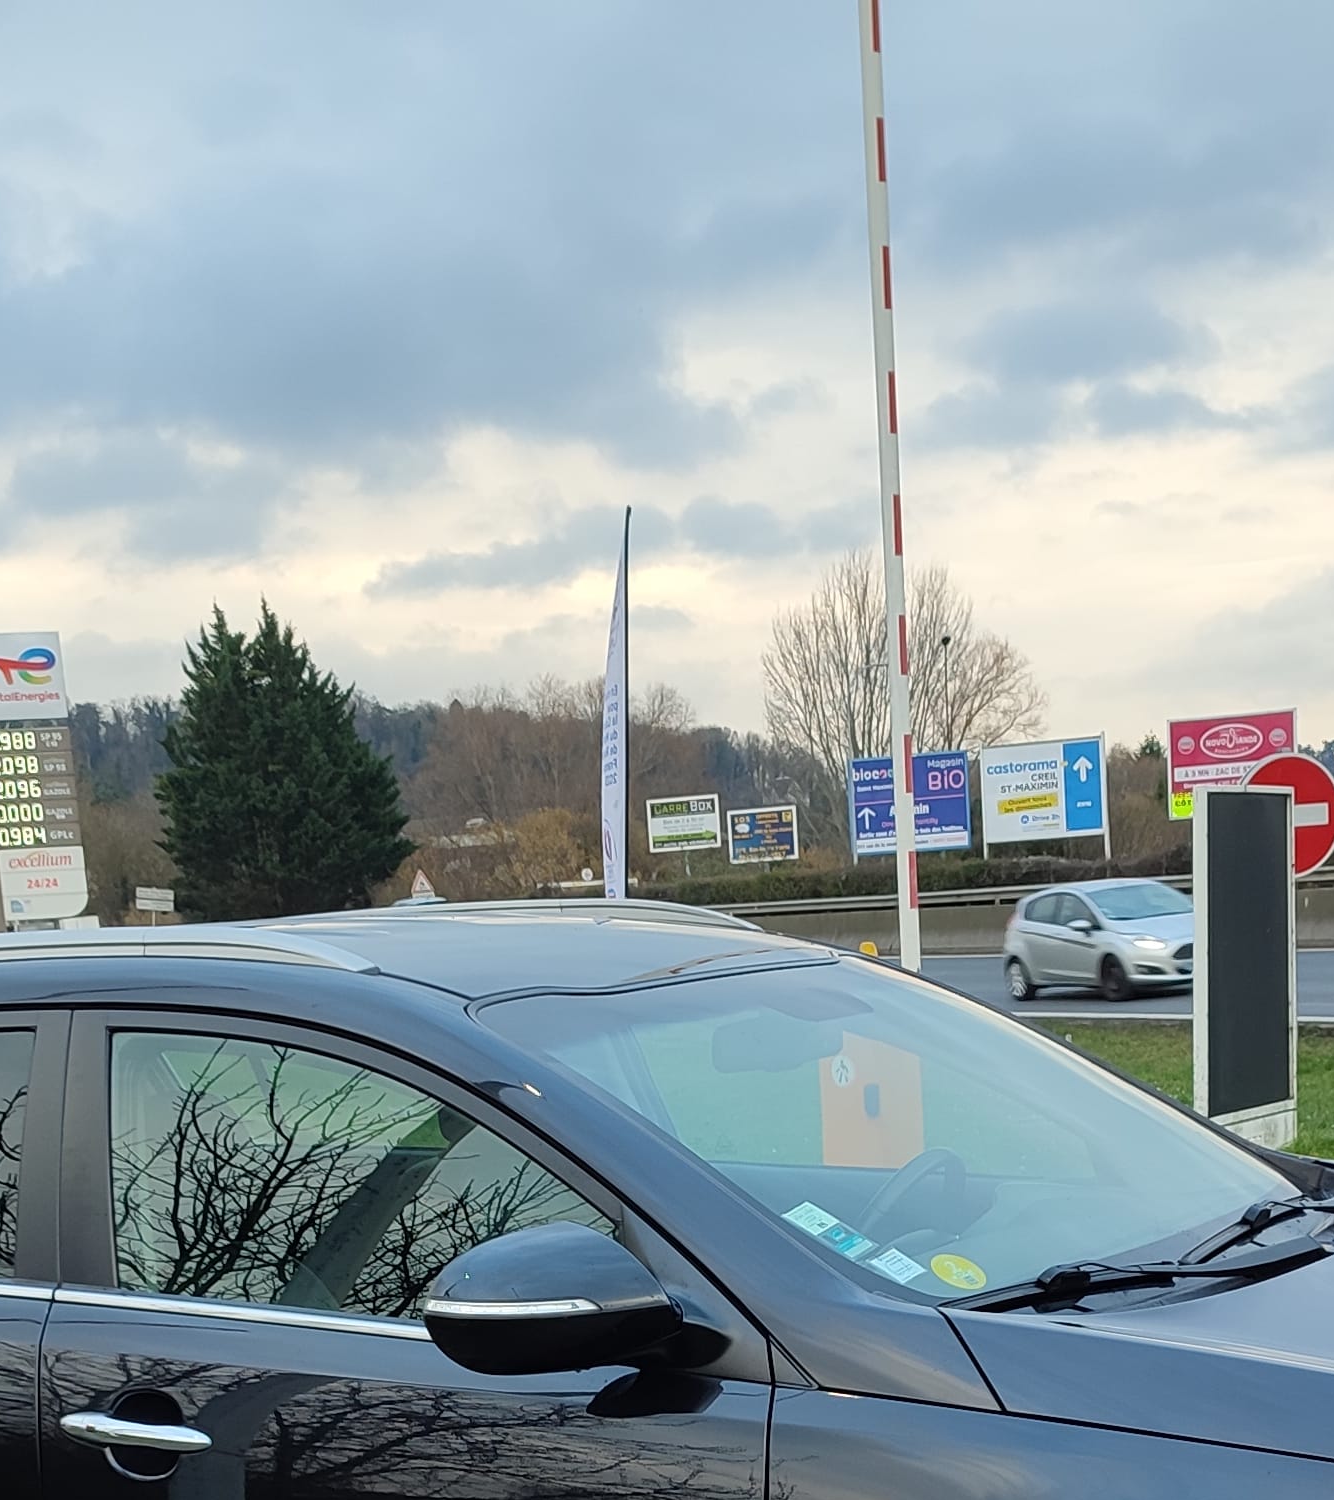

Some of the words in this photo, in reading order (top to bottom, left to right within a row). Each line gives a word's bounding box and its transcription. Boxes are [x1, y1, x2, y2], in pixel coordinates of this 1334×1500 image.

[927, 757, 964, 769] Magasin
[986, 760, 1058, 775] castorama
[1030, 772, 1058, 782] CREIL
[26, 877, 59, 889] 24/24
